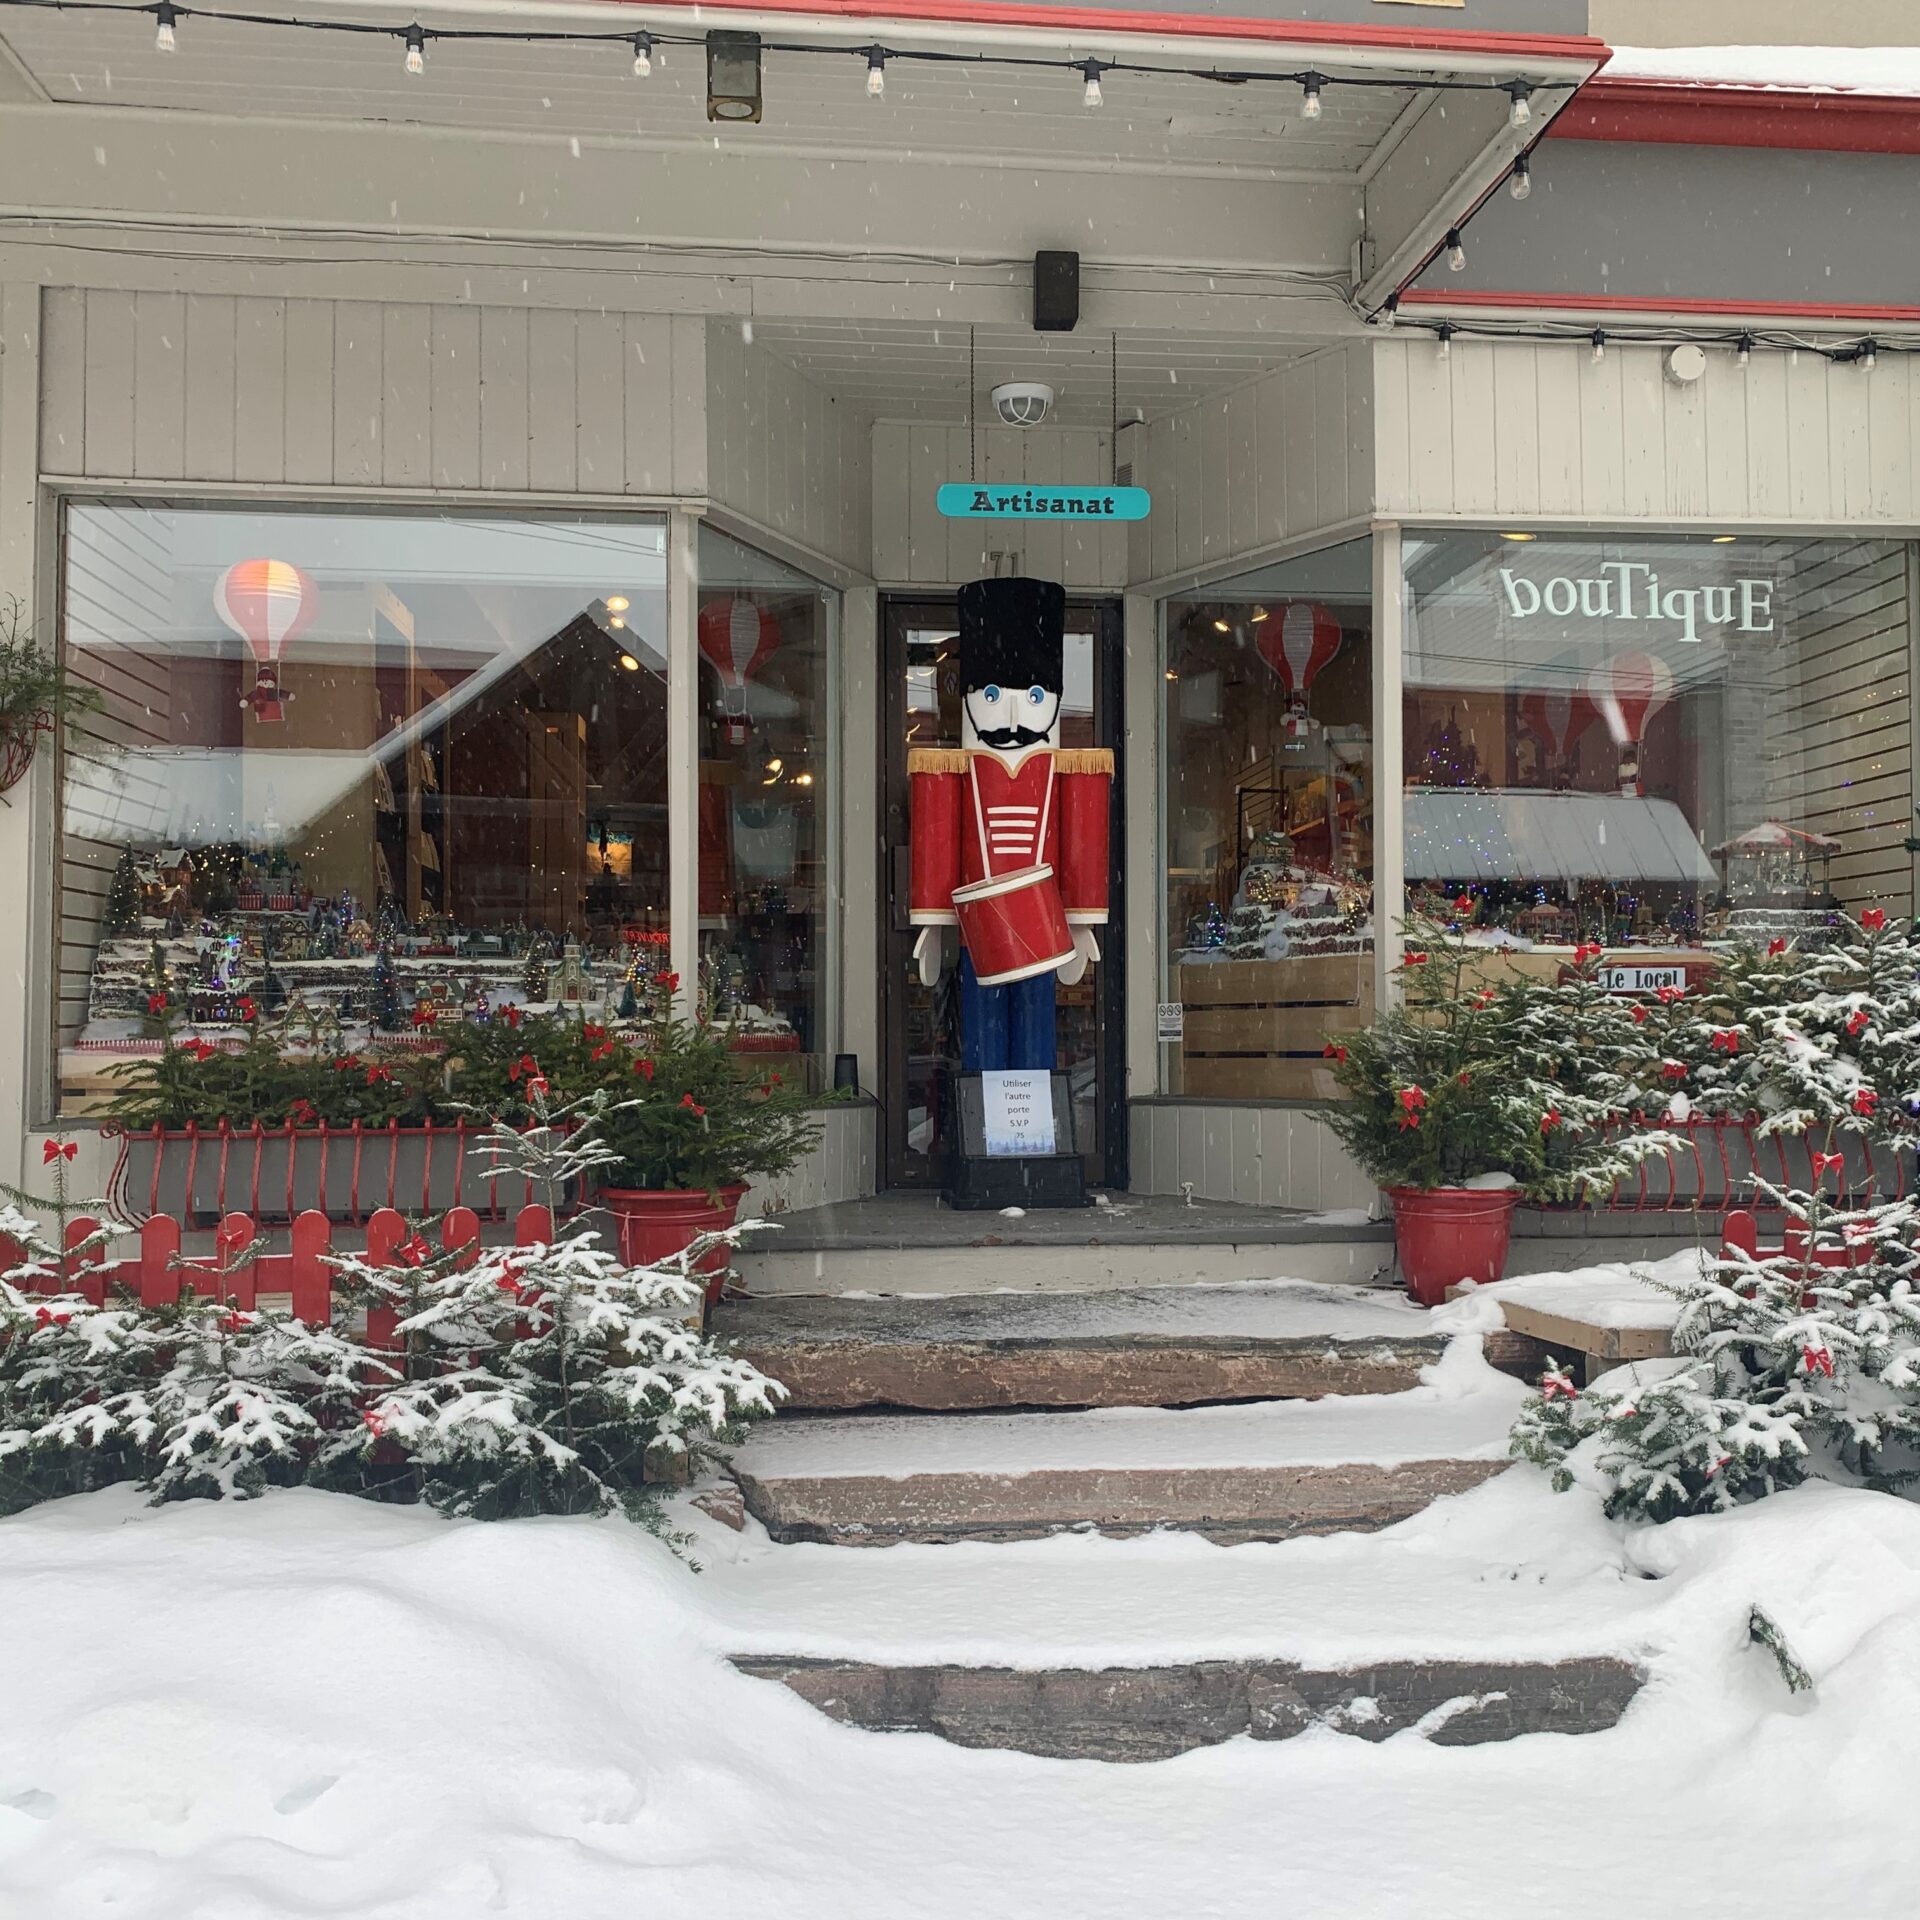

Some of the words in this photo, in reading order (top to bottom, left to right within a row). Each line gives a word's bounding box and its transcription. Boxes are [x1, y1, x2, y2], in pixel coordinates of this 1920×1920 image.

[969, 490, 1114, 514] Artisanat
[1635, 970, 1677, 989] Local
[1002, 1080, 1032, 1088] Utiliser
[1004, 1092, 1031, 1100] l'autre
[1007, 1107, 1030, 1115] porte
